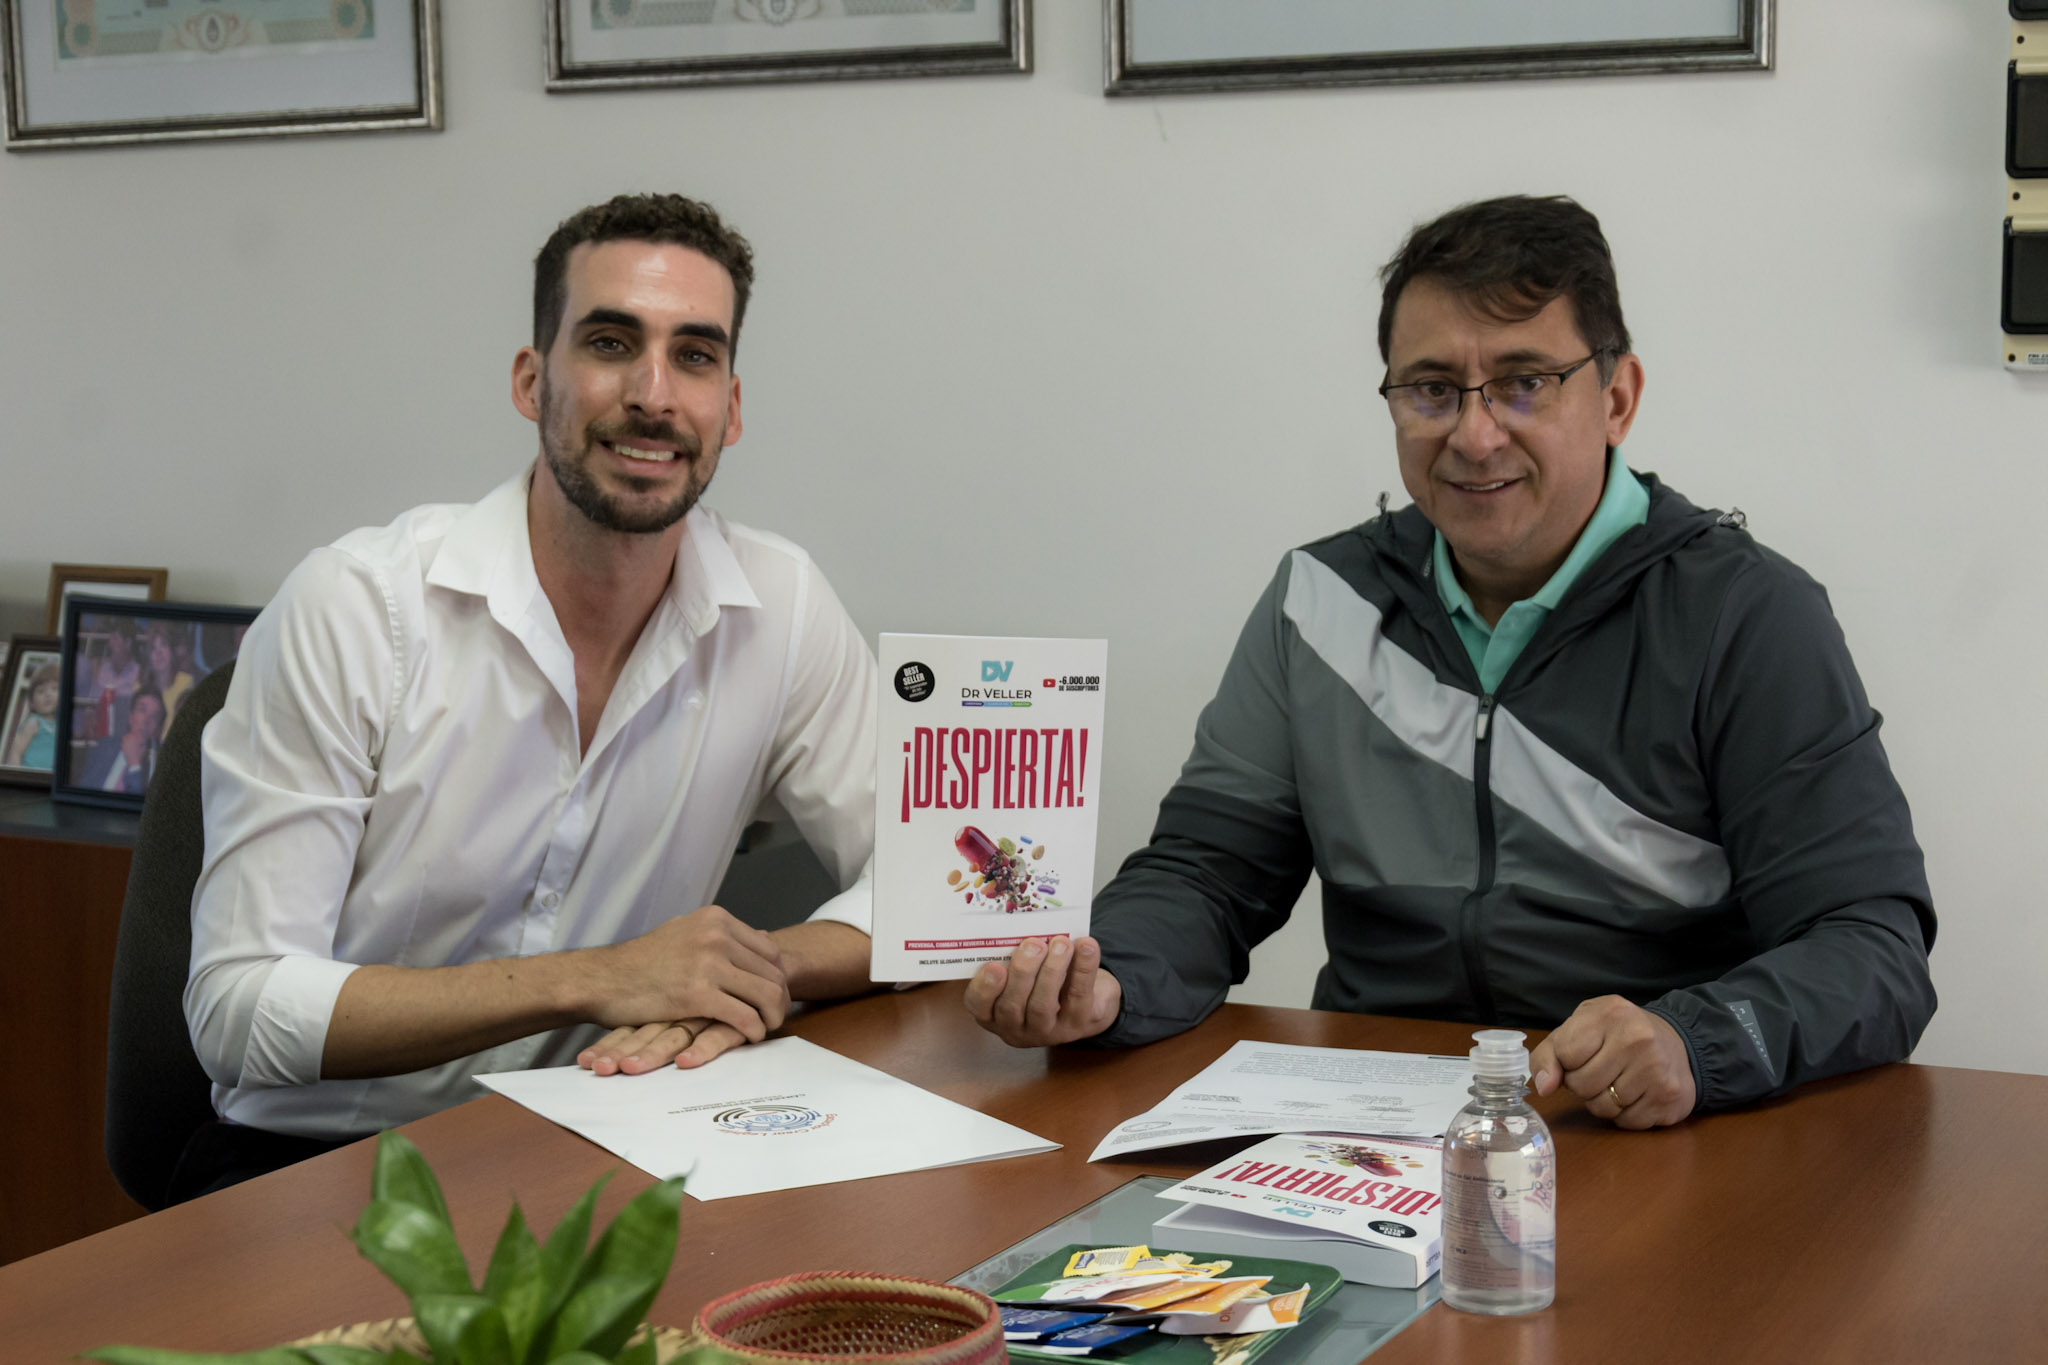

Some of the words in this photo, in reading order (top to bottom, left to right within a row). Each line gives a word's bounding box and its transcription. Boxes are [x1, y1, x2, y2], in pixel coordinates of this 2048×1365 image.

[903, 665, 919, 677] BEST
[981, 660, 1014, 682] DV
[902, 672, 926, 686] SELLER
[1059, 676, 1100, 685] +6.000.000
[983, 688, 1032, 699] VELLER
[901, 726, 1088, 823] ¡DESPIERTA!
